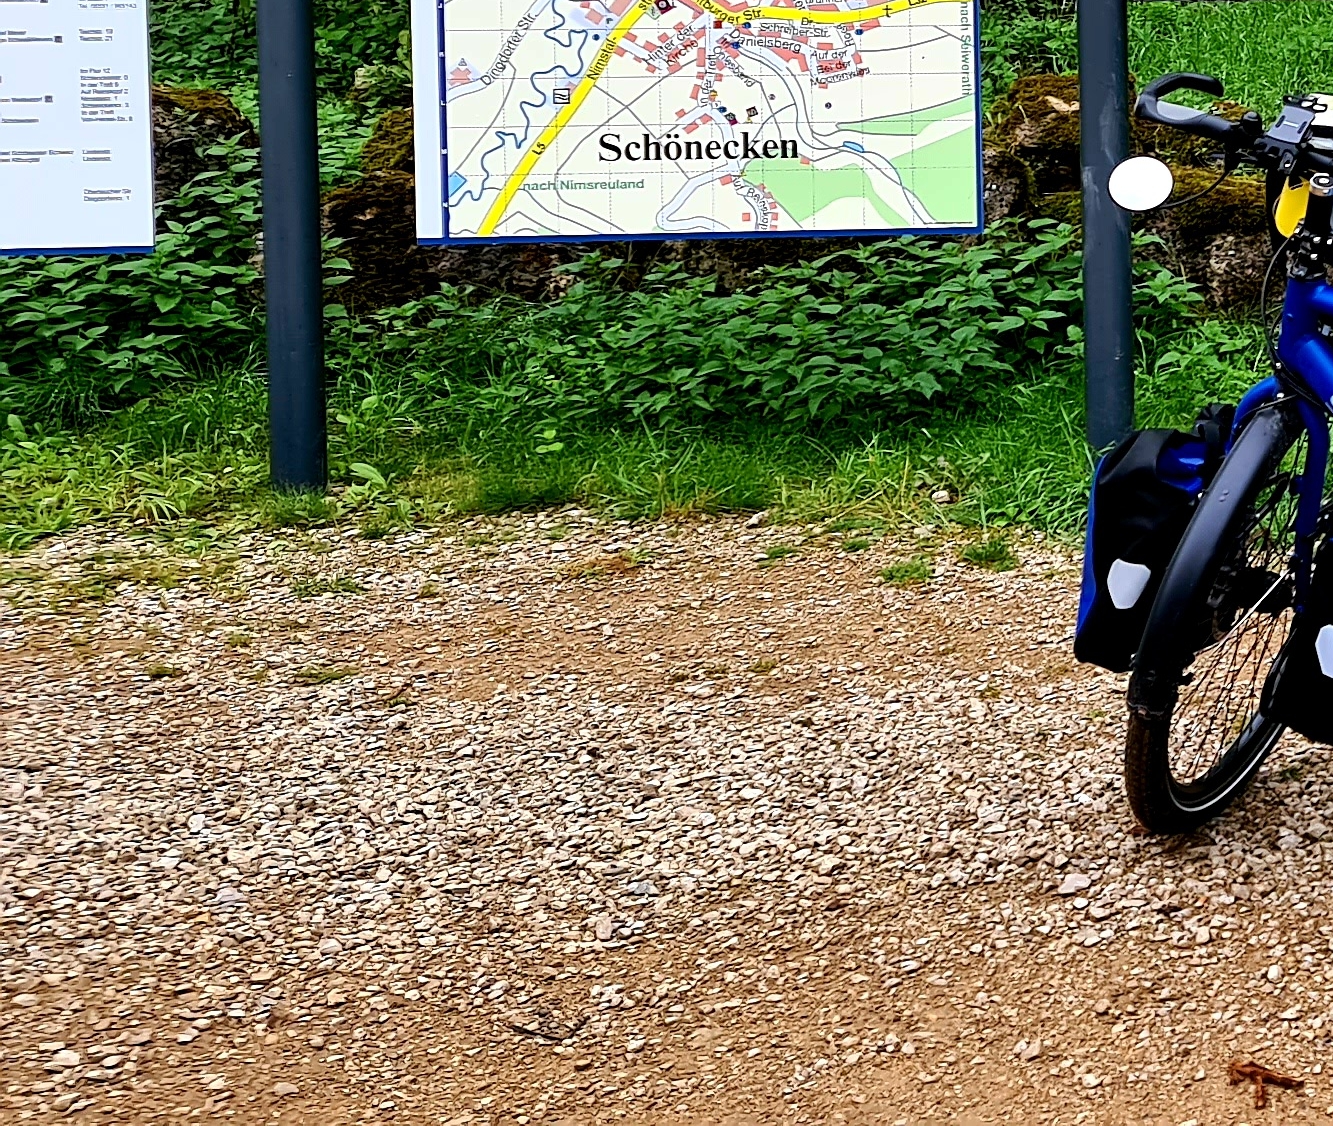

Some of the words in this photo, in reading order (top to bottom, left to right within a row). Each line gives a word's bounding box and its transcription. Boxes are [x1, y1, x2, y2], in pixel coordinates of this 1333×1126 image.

[743, 9, 764, 21] Str.
[643, 39, 675, 64] Hinter
[729, 29, 801, 52] Danielsberg
[586, 36, 617, 80] Nimstal-
[531, 142, 546, 155] L5
[599, 131, 799, 162] Schönecken
[523, 180, 556, 191] nach
[560, 178, 645, 190] Nimsreuland
